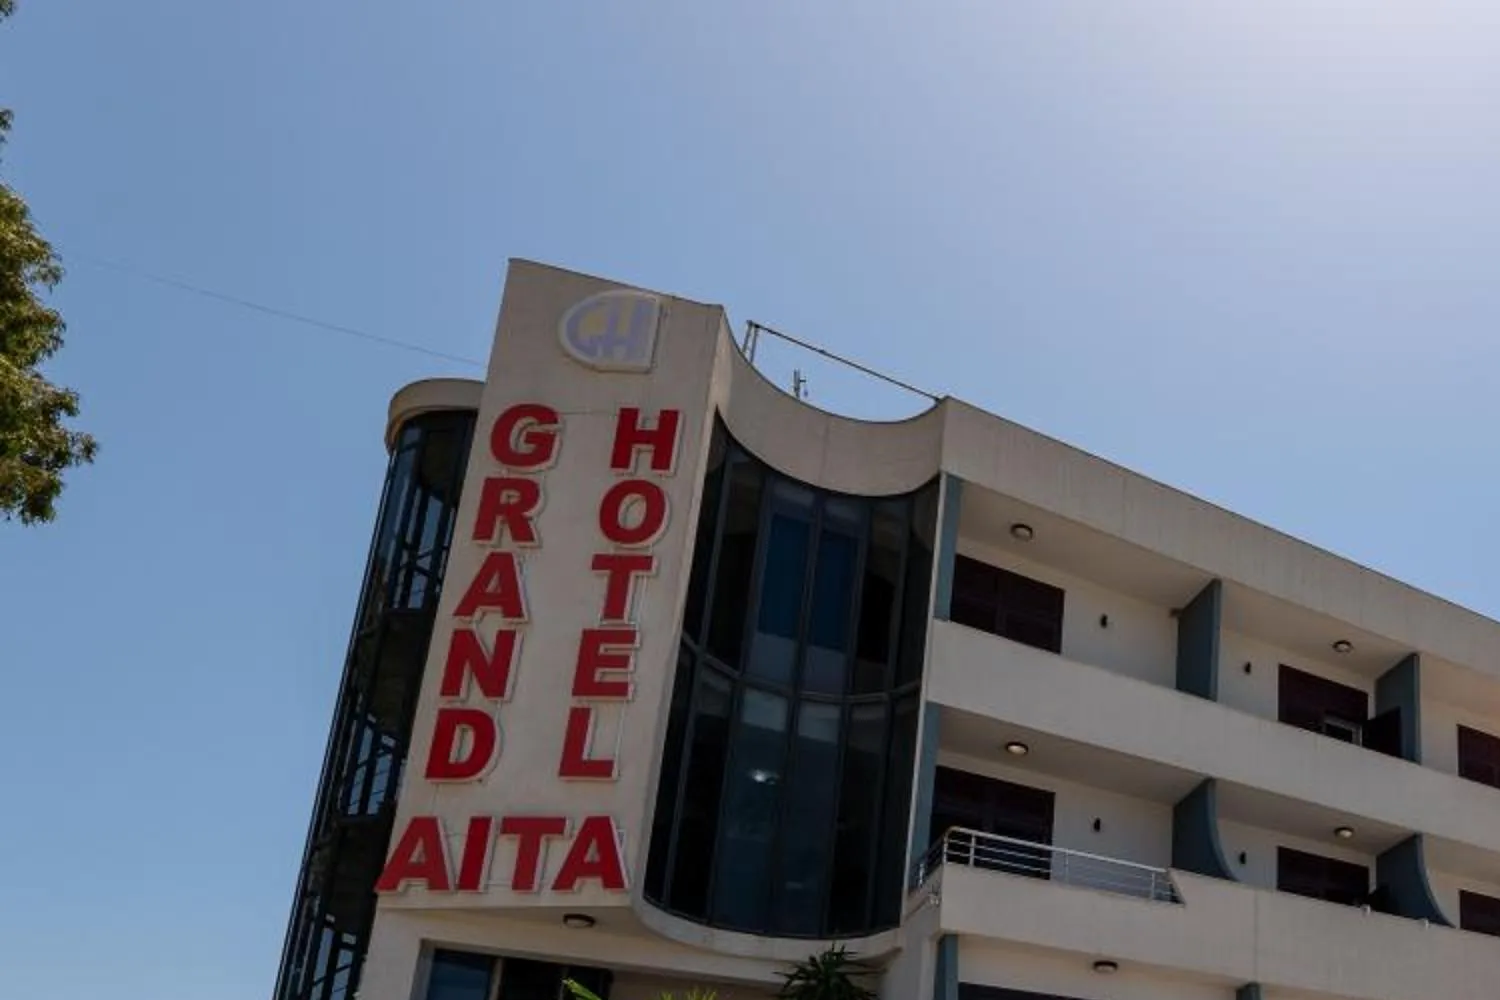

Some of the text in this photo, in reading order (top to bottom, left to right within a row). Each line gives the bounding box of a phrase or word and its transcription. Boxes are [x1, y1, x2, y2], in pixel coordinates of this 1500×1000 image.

[424, 404, 560, 784] GRAND
[560, 407, 680, 781] HOTEL
[375, 815, 626, 894] AITA
